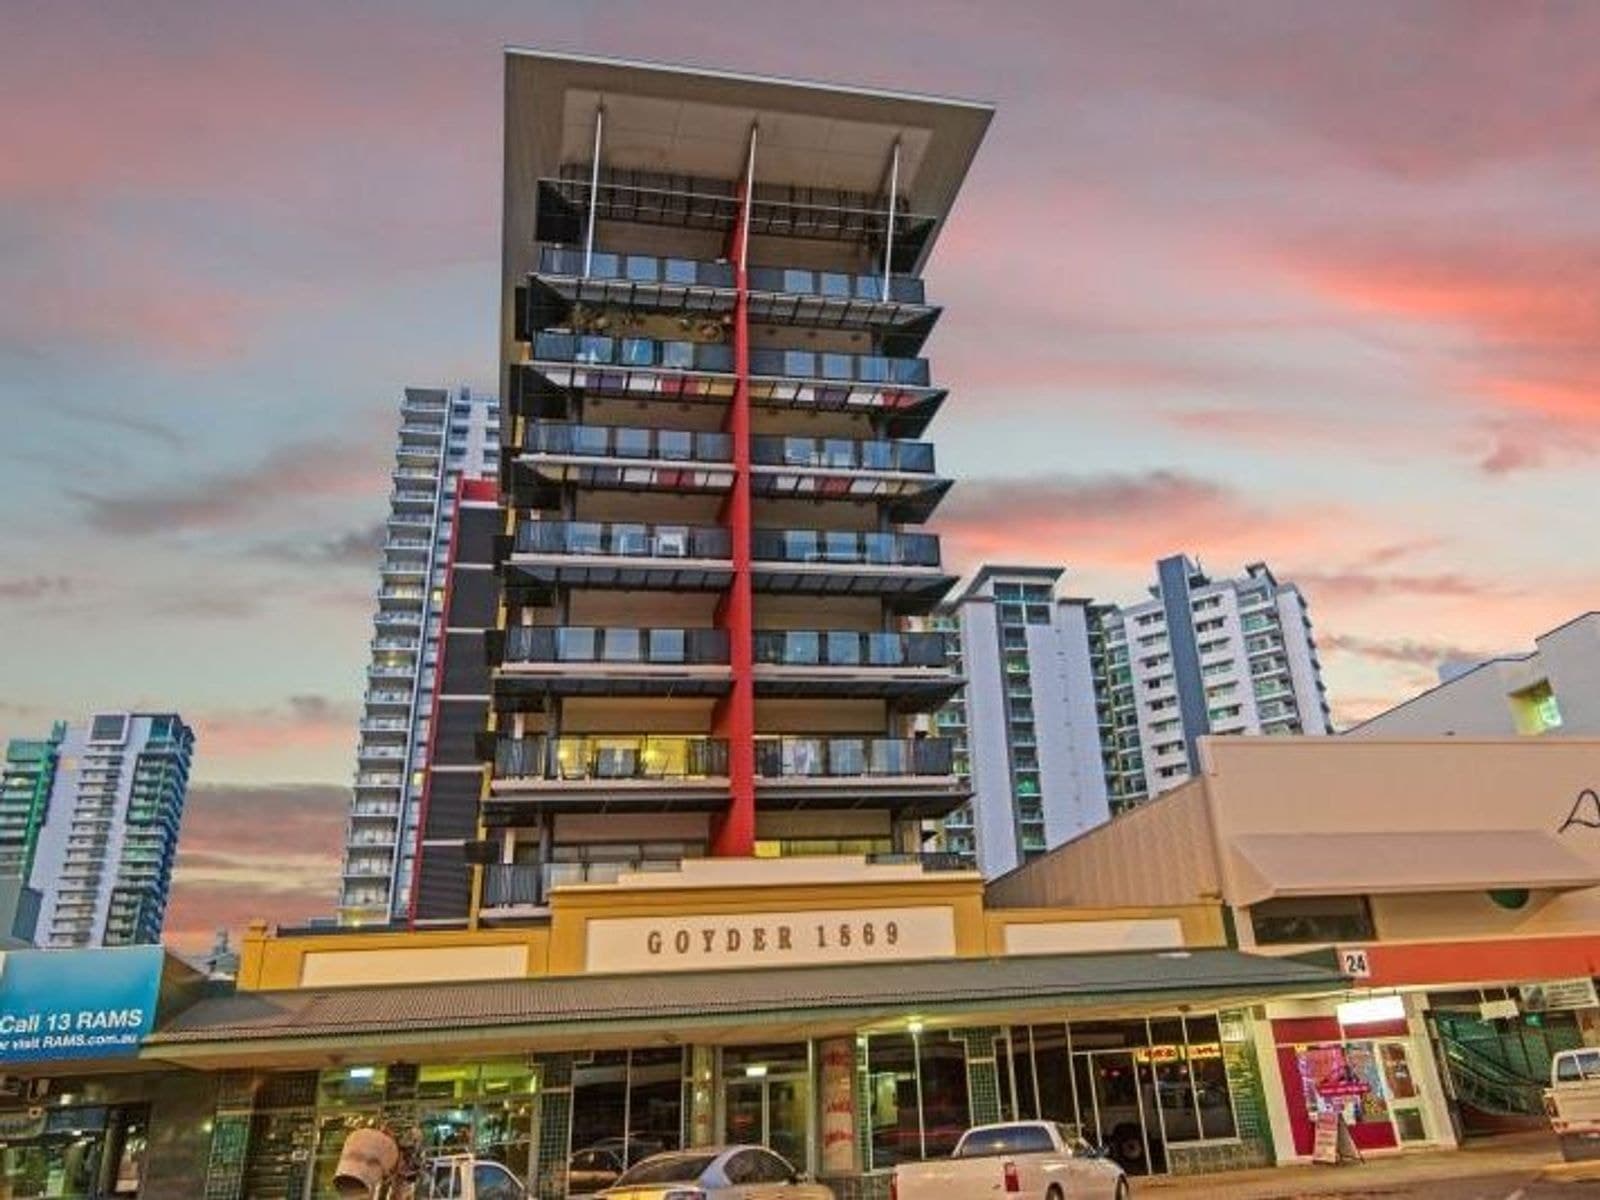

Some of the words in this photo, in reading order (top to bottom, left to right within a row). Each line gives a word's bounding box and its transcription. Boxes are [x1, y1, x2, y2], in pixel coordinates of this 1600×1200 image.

[646, 926, 793, 954] GOYDER
[817, 921, 898, 948] 1869
[1346, 954, 1366, 972] 24
[0, 1013, 40, 1034] Call
[47, 1013, 71, 1031] 13
[76, 1009, 143, 1030] RAMS
[13, 1037, 40, 1050] visit
[42, 1033, 137, 1049] RAMS.com.au
